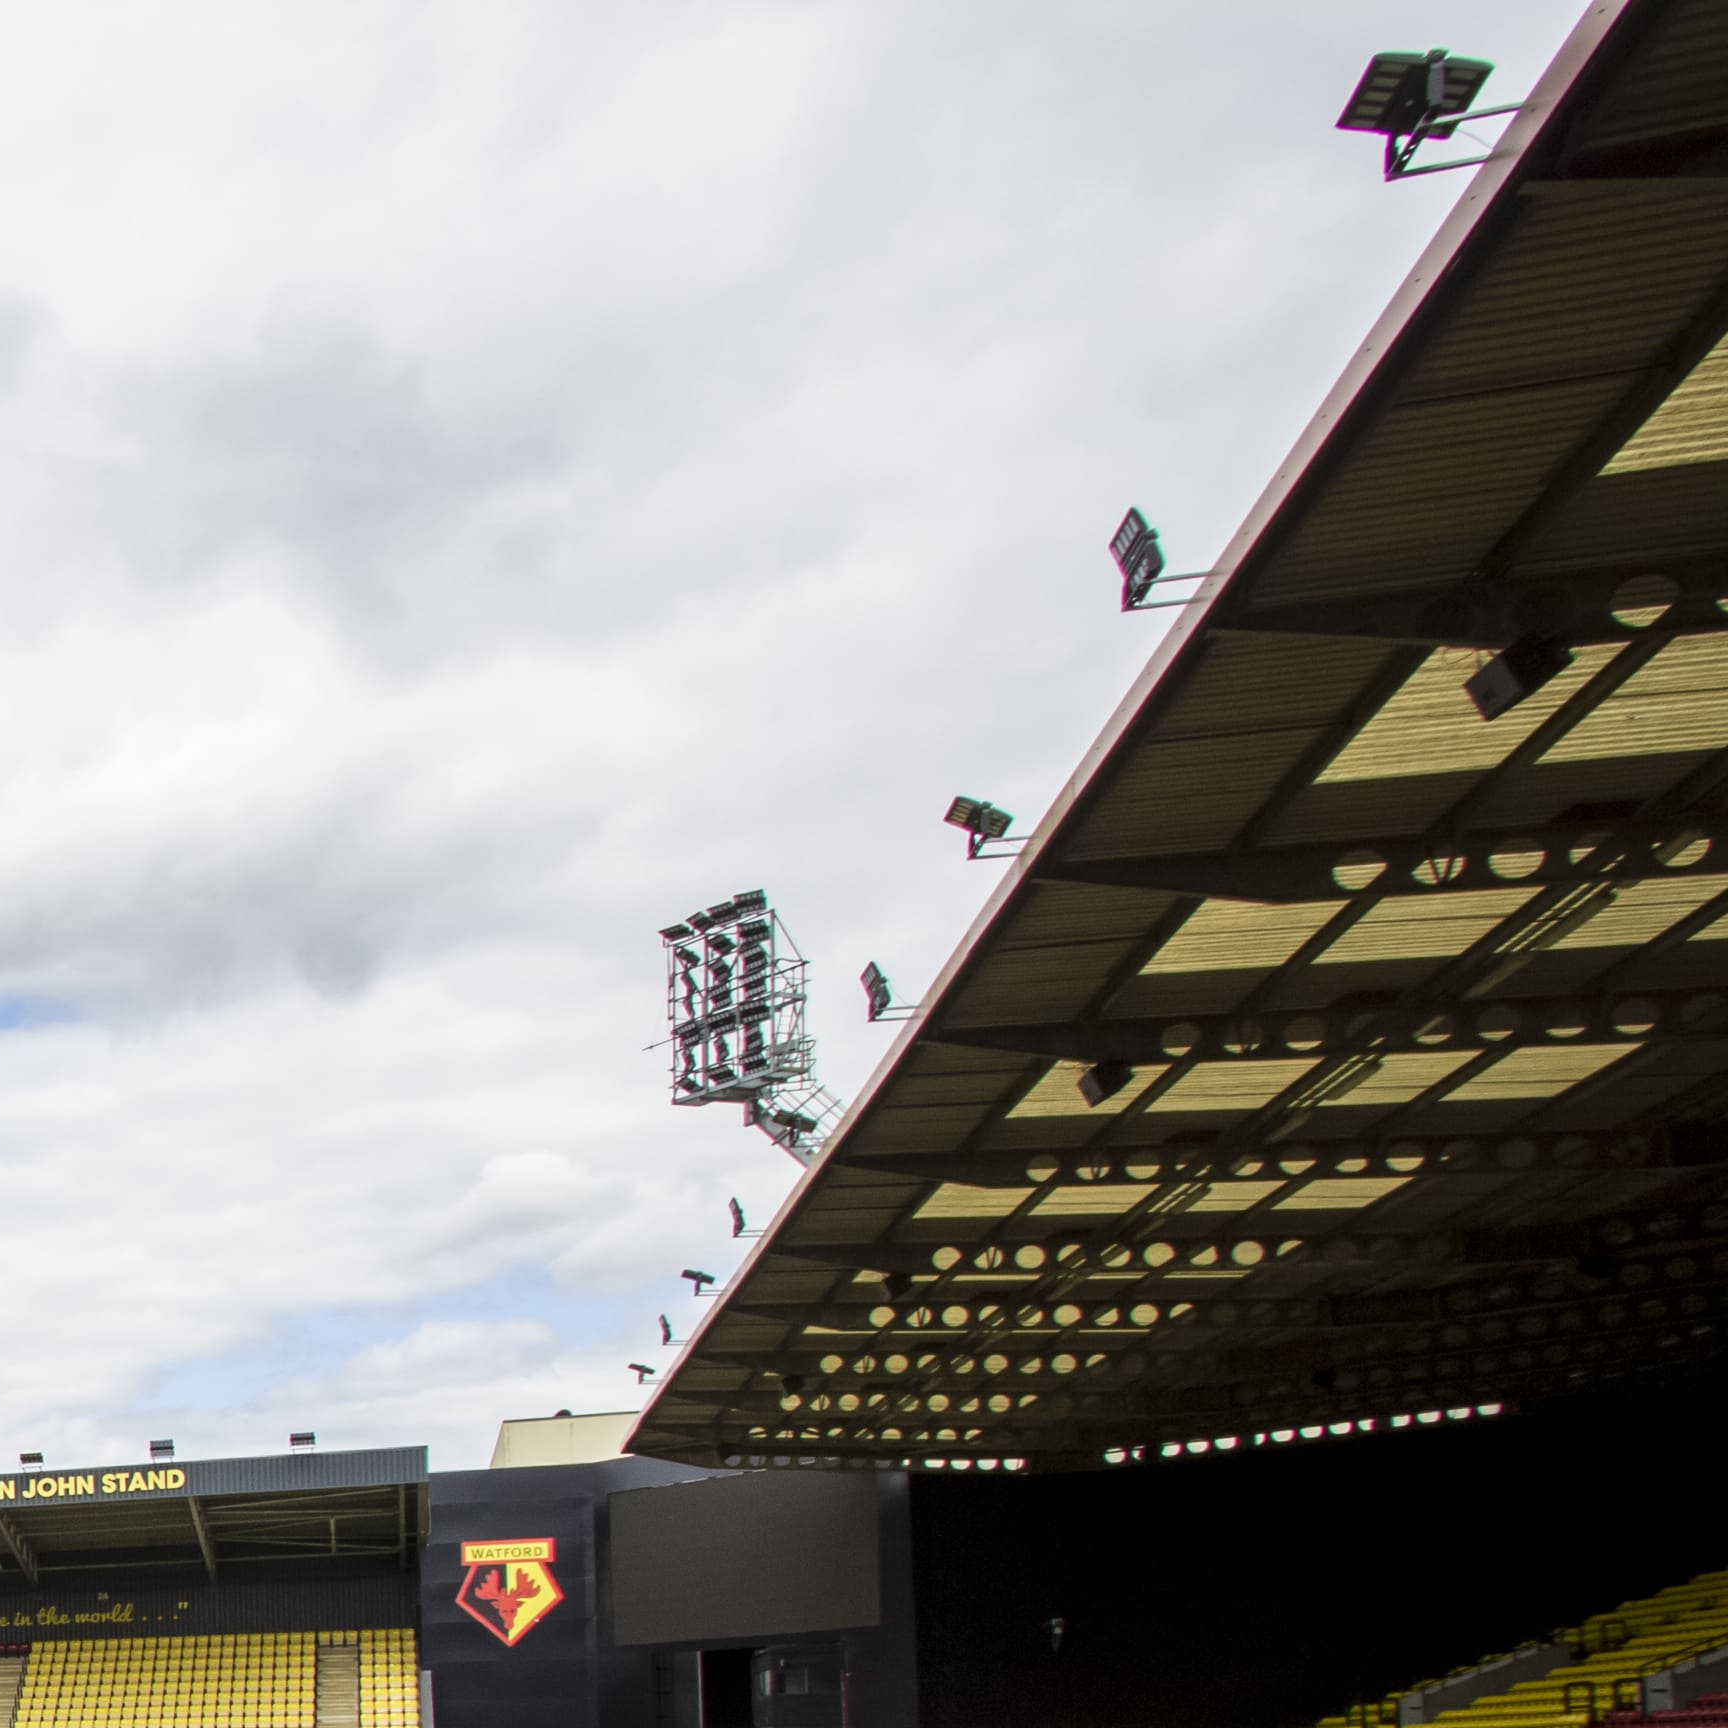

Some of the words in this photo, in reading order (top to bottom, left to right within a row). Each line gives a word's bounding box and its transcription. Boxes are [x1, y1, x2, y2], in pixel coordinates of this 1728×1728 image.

[22, 1475, 95, 1499] JOHN
[102, 1469, 186, 1494] STAND
[470, 1546, 543, 1559] WATFORD
[13, 1612, 33, 1626] in
[36, 1606, 71, 1625] the
[75, 1603, 133, 1623] world
